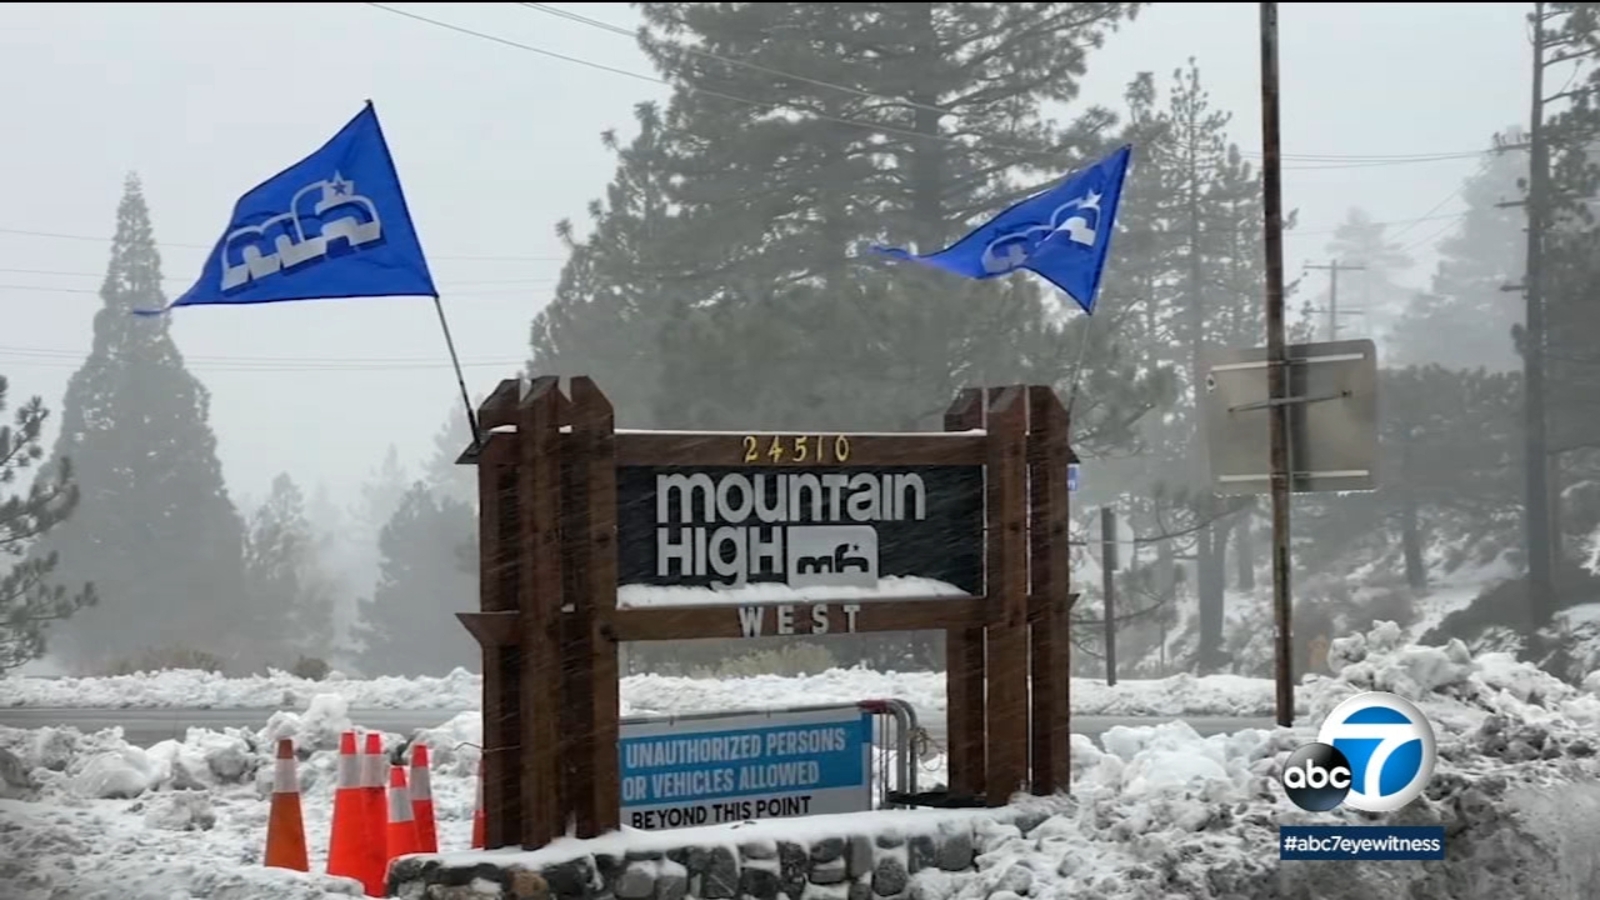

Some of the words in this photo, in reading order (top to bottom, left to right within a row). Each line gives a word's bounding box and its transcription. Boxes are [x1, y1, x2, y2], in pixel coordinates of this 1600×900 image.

[742, 435, 851, 463] 24510
[739, 604, 861, 637] WEST
[626, 734, 761, 769] UNAUTHORIZED
[766, 727, 846, 757] PERSONS
[622, 775, 647, 800] OR
[653, 767, 735, 798] VEHICLES
[739, 760, 820, 789] ALLOWED
[631, 806, 708, 830] BEYOND
[712, 801, 752, 822] THIS
[756, 795, 812, 818] POINT
